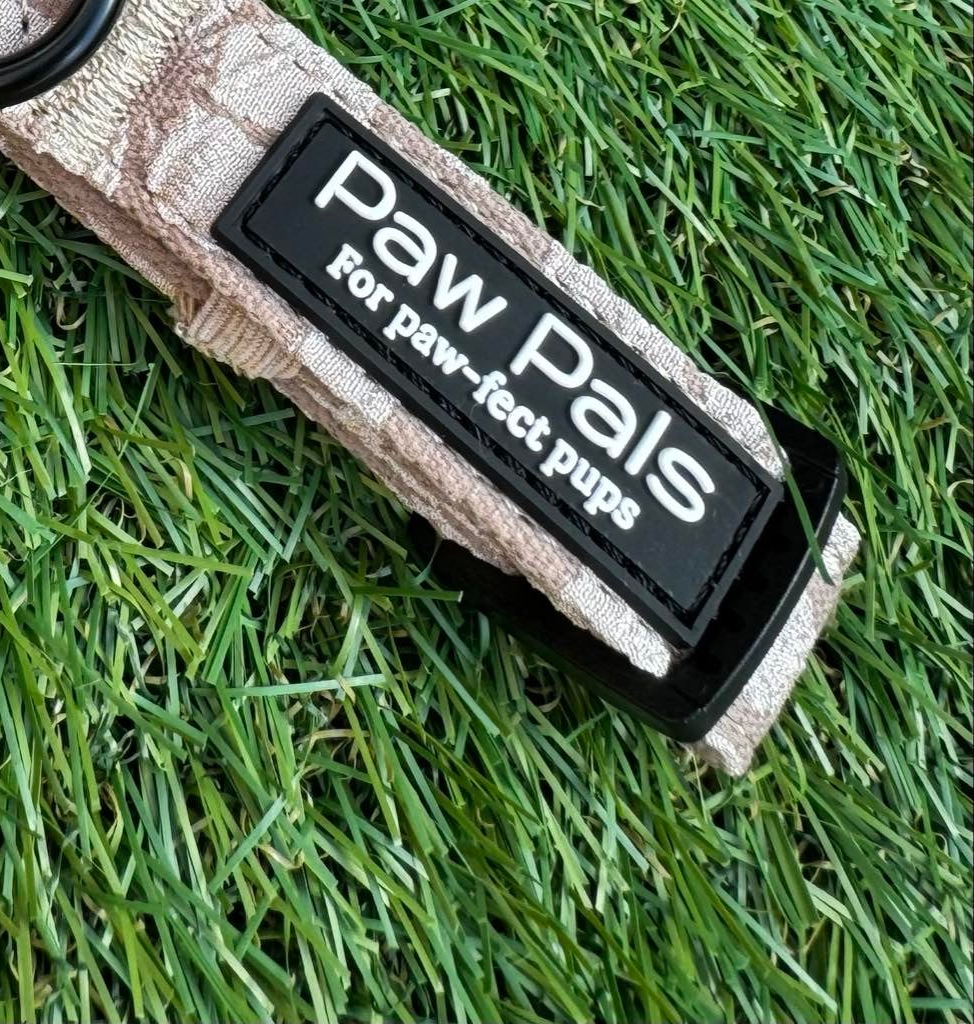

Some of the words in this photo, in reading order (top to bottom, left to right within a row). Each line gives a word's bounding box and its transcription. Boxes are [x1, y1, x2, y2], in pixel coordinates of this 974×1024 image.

[314, 149, 508, 334] Paw
[510, 311, 718, 523] Pals
[325, 243, 395, 312] For
[382, 302, 550, 453] paw-fect
[538, 438, 641, 530] pups
